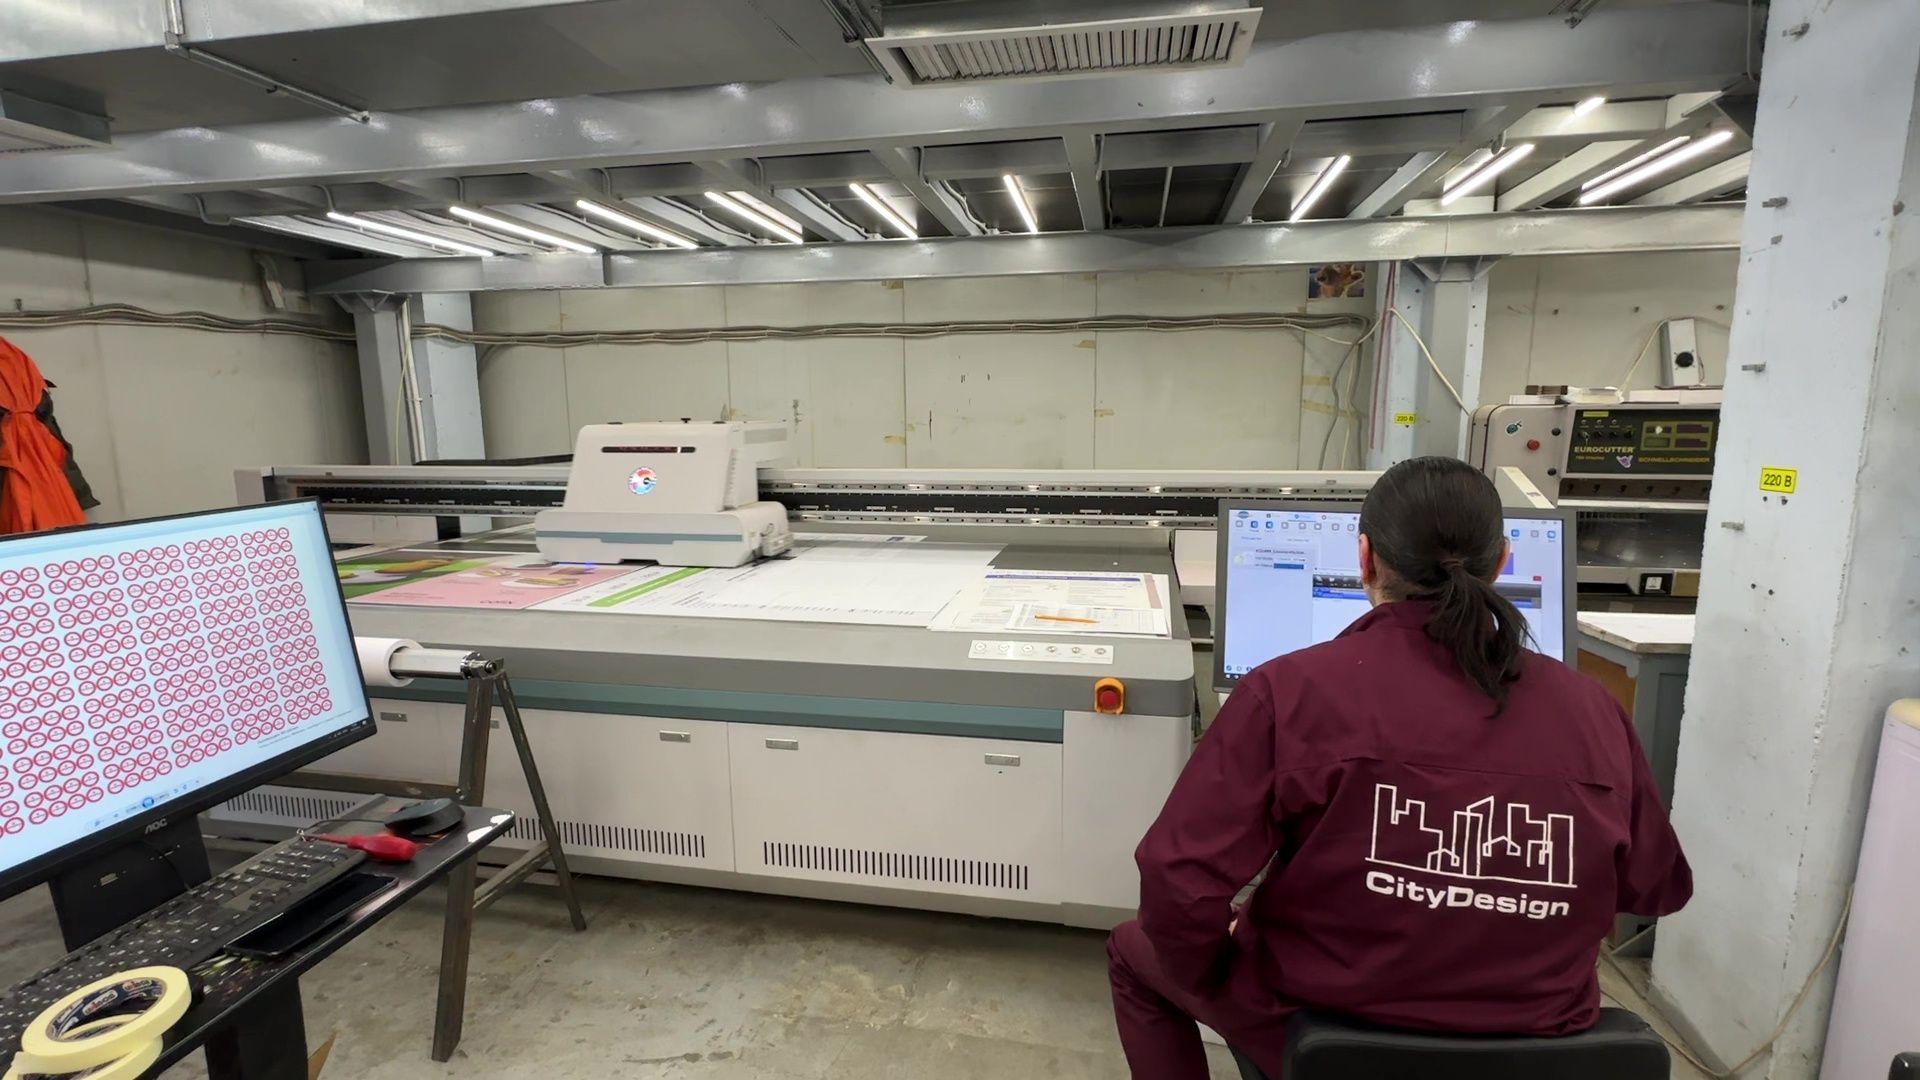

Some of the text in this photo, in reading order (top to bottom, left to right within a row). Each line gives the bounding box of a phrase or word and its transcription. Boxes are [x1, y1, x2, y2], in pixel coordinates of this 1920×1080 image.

[1763, 473, 1782, 486] 220
[145, 818, 168, 834] AOC
[1366, 871, 1570, 919] CityDesign
